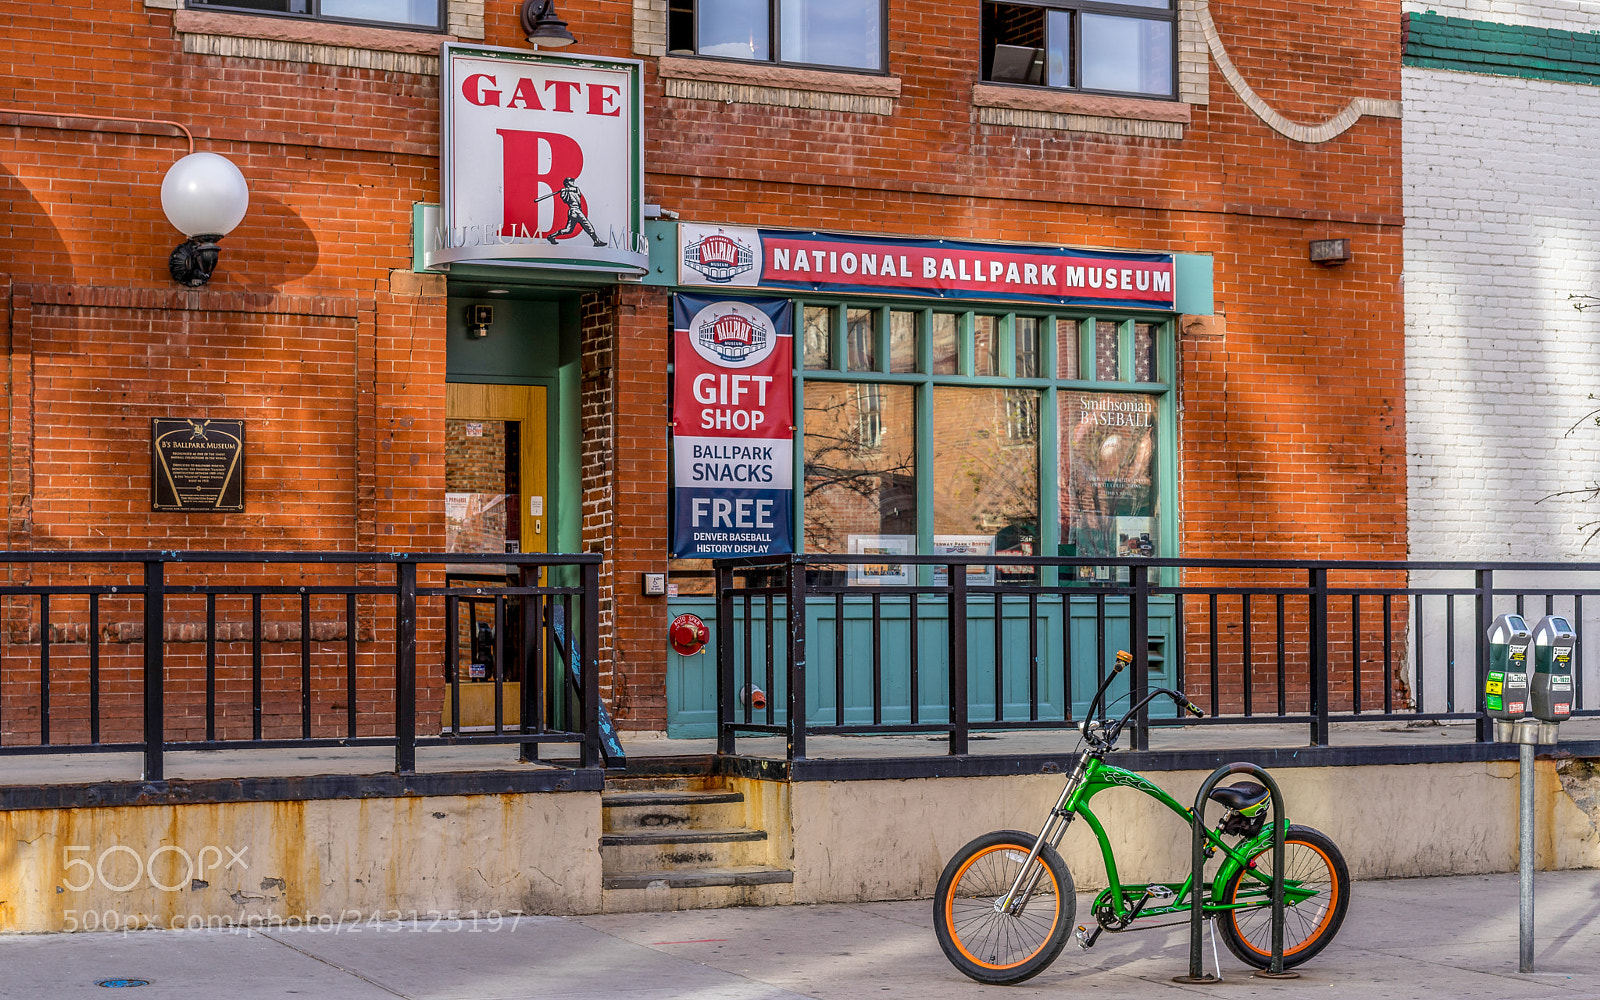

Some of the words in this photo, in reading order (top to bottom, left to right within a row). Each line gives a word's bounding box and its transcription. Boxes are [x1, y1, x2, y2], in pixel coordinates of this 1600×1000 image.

[462, 73, 621, 117] GATE
[496, 128, 588, 239] B
[434, 222, 545, 251] MUSEUM
[702, 241, 737, 263] BALLPARK
[773, 248, 913, 278] NATIONAL
[922, 257, 1057, 286] BALLPARK
[1066, 266, 1171, 292] MUSEUM
[716, 320, 751, 342] BALLPARK
[692, 373, 773, 406] GIFT
[1080, 395, 1152, 412] Smithsonian
[701, 408, 765, 431] SHOP
[1081, 410, 1152, 427] BASEBALL
[173, 441, 205, 449] BALLPARK
[693, 445, 773, 460] BALLPARK
[692, 463, 773, 482] SNACKS
[691, 498, 774, 529] FREE
[693, 532, 728, 541] DENVER
[729, 533, 772, 542] BASEBALL
[696, 544, 732, 553] HISTORY
[734, 545, 769, 553] DISPLAY
[674, 616, 686, 626] AUTO
